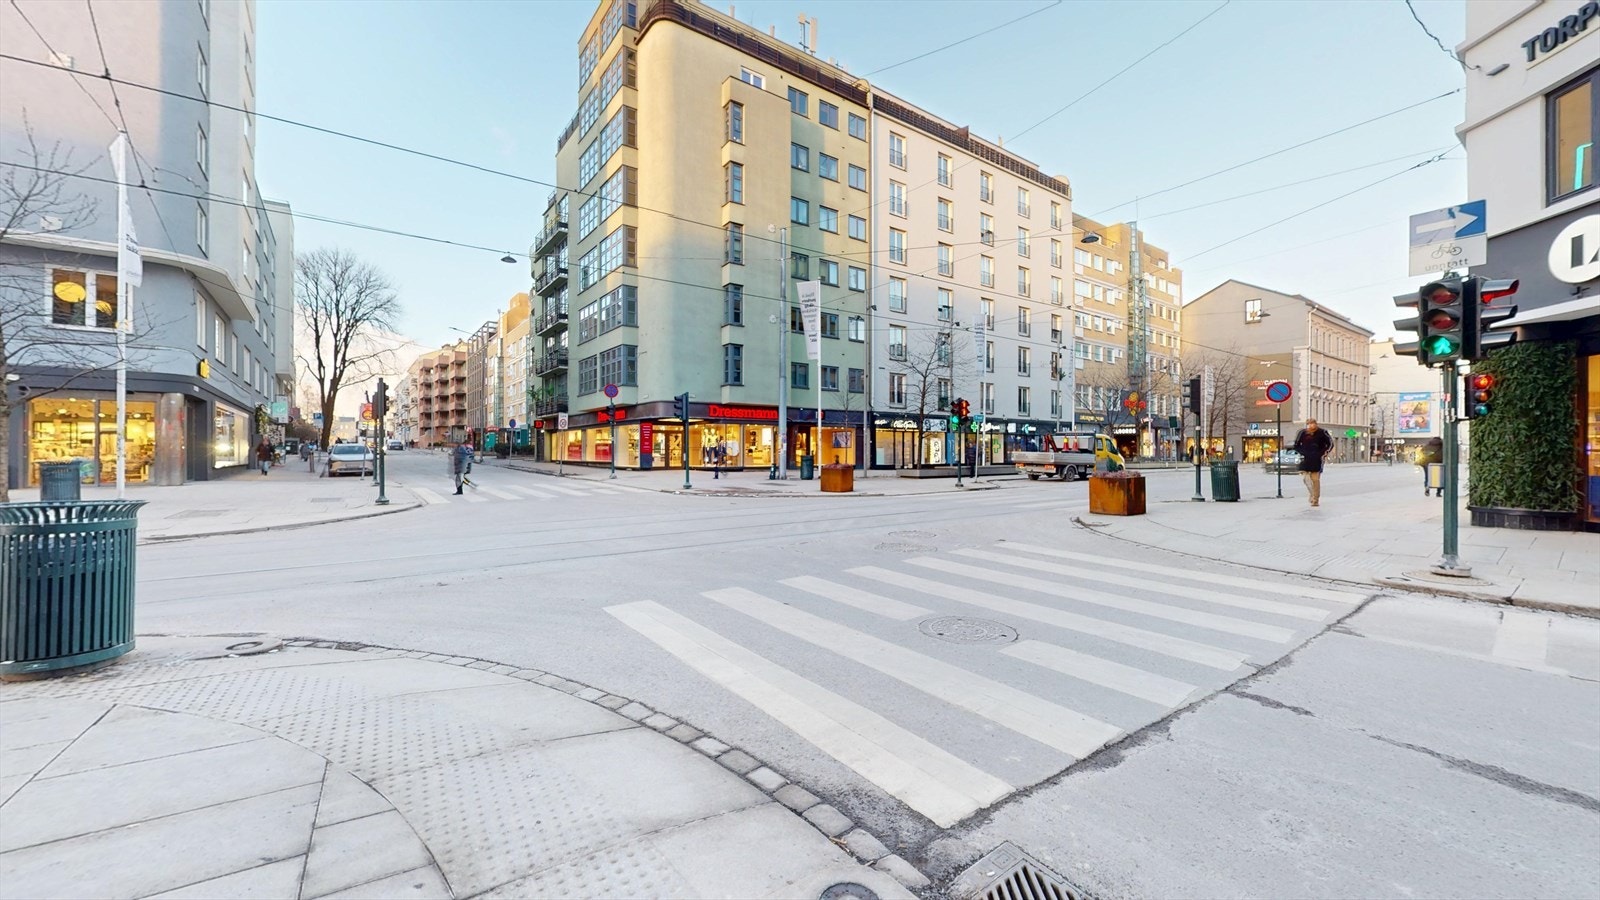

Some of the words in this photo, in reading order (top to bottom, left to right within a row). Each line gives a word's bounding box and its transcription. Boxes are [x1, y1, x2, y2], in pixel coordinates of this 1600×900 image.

[1521, 2, 1600, 62] TORP
[1425, 258, 1468, 271] unntatt
[709, 405, 779, 419] Dressmann
